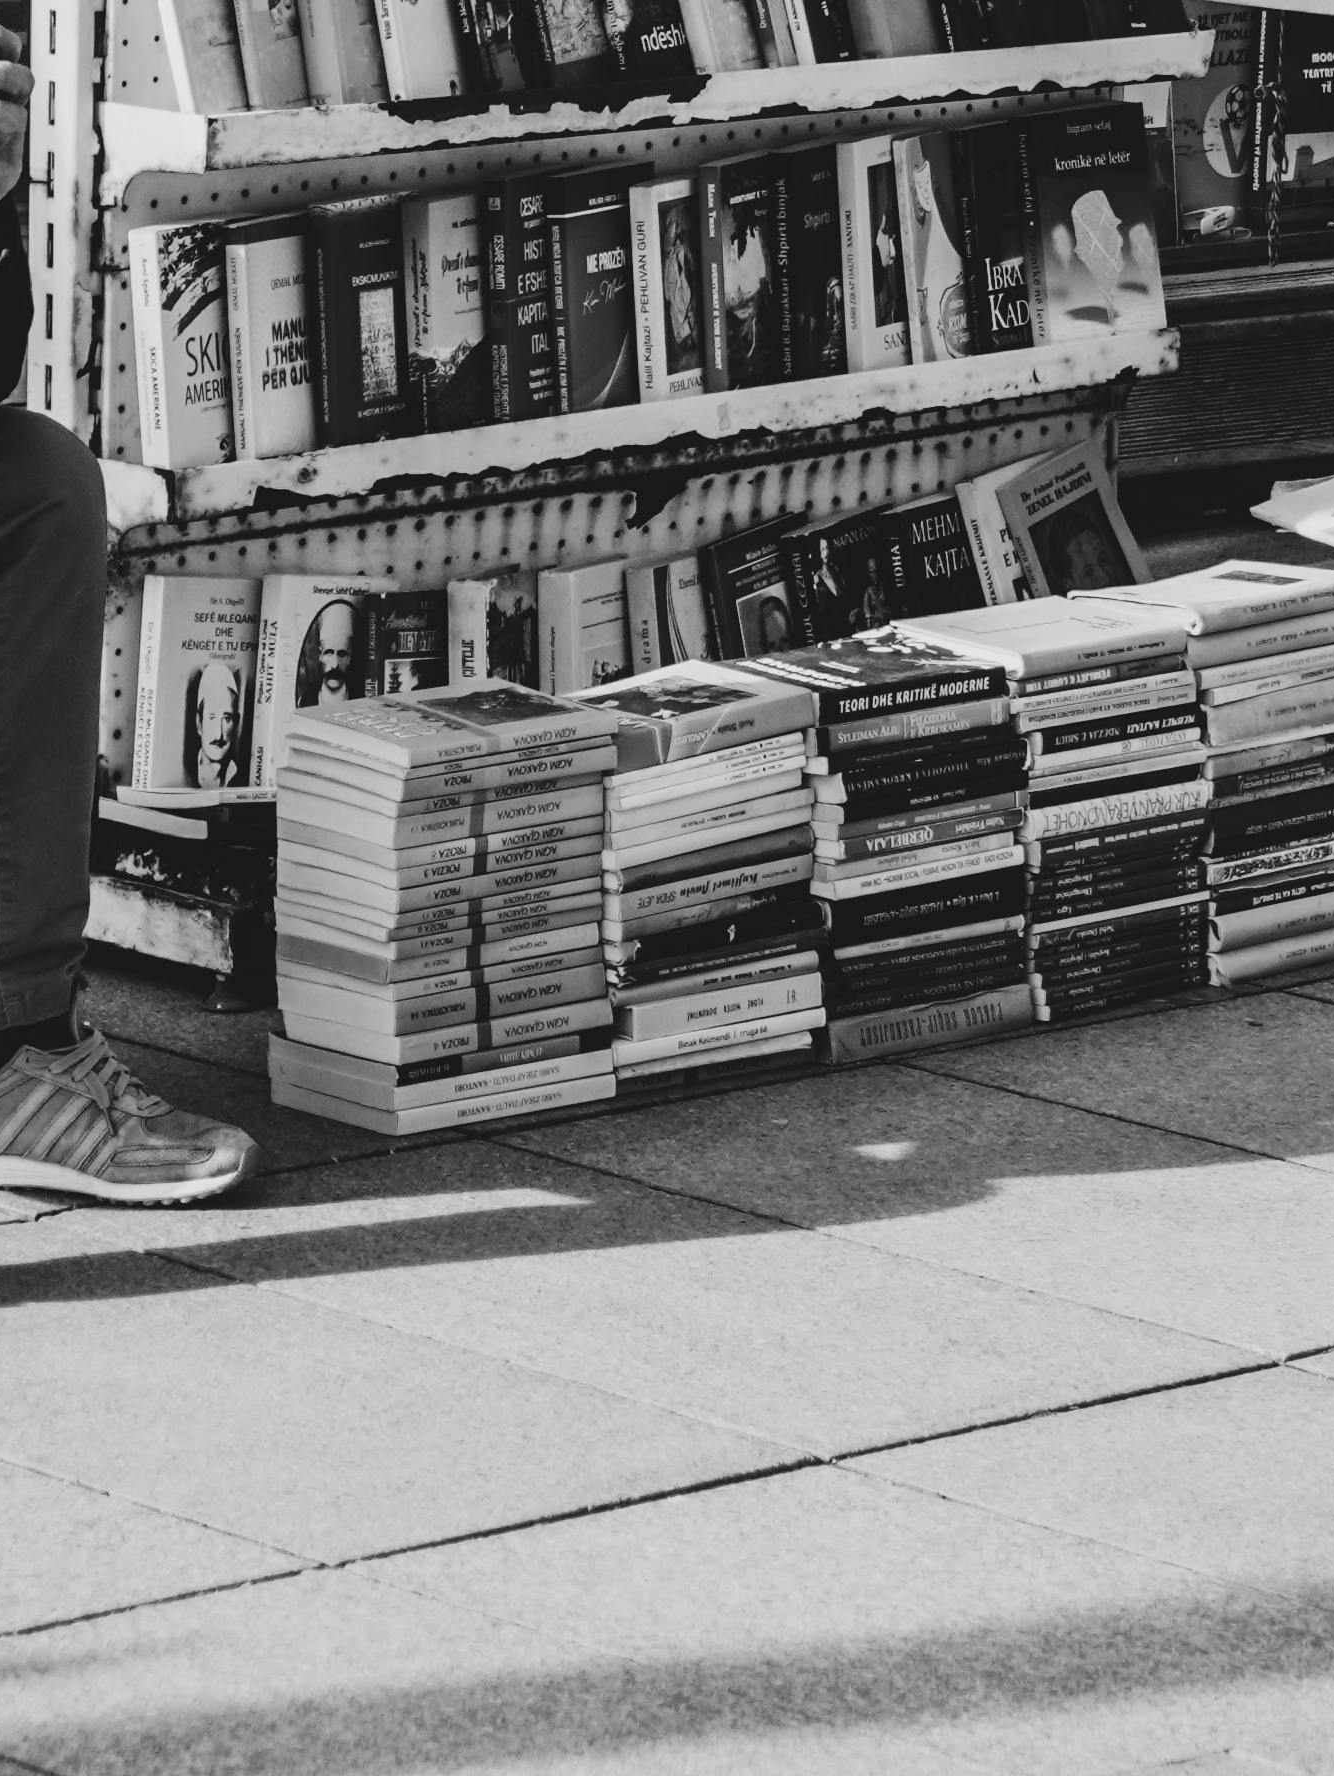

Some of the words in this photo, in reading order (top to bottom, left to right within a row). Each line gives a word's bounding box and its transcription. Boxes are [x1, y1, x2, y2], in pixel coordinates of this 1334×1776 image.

[821, 0, 829, 16] ali
[1321, 81, 1333, 95] TË
[1054, 155, 1092, 171] kronikë
[1094, 154, 1107, 166] në
[1108, 151, 1131, 165] letër
[519, 194, 543, 217] CESARE
[775, 177, 788, 219] binjak
[636, 220, 646, 251] GURI
[777, 221, 790, 266] Shpirti
[586, 253, 598, 274] ME
[598, 246, 626, 271] PROZËN
[517, 275, 524, 295] E
[638, 253, 650, 314] PEHLIVAN
[779, 278, 792, 331] Bajraktari
[1034, 289, 1043, 305] në
[643, 324, 653, 362] Kajtazi
[783, 345, 795, 375] Sabit
[262, 366, 287, 392] PËR
[644, 362, 655, 389] Halil
[152, 377, 162, 431] AMERIKANE
[194, 611, 216, 624] SEFË
[216, 613, 257, 626] MLEQANI
[214, 627, 233, 638] DHE
[268, 620, 278, 656] MULA
[181, 638, 217, 651] KËNGËT
[640, 619, 651, 664] drama
[838, 693, 869, 714] TEORI
[871, 691, 893, 709] DHE
[896, 683, 937, 705] KRITIKË
[939, 676, 990, 698] MODERNE
[513, 730, 553, 746] GJAKOVA
[554, 727, 577, 739] AGIM
[254, 746, 264, 788] CANHASI
[507, 760, 547, 777] GJAKOVA
[549, 757, 573, 769] AGIM
[443, 774, 473, 787] PROZA
[535, 778, 559, 790] AGIM
[494, 782, 534, 798] GJAKOVA
[432, 796, 461, 808] PROZA
[537, 801, 561, 813] AGIM
[497, 804, 536, 820] GJAKOVA
[501, 829, 540, 846] GJAKOVA
[541, 826, 565, 838] AGIM
[865, 826, 934, 852] QERBELAJA
[438, 844, 467, 857] PROZA
[494, 848, 533, 865] GJAKOVA
[534, 845, 558, 857] AGIM
[429, 863, 461, 876] POEZIA
[534, 867, 558, 880] AGIM
[494, 871, 533, 888] GJAKOVA
[433, 886, 461, 899] PROZA
[497, 987, 537, 1004] GJAKOVA
[538, 982, 562, 996] AGIM
[504, 1020, 544, 1037] GJAKOVA
[545, 1016, 569, 1029] AGIM
[758, 1025, 768, 1036] 66
[440, 1036, 469, 1048] PROZA
